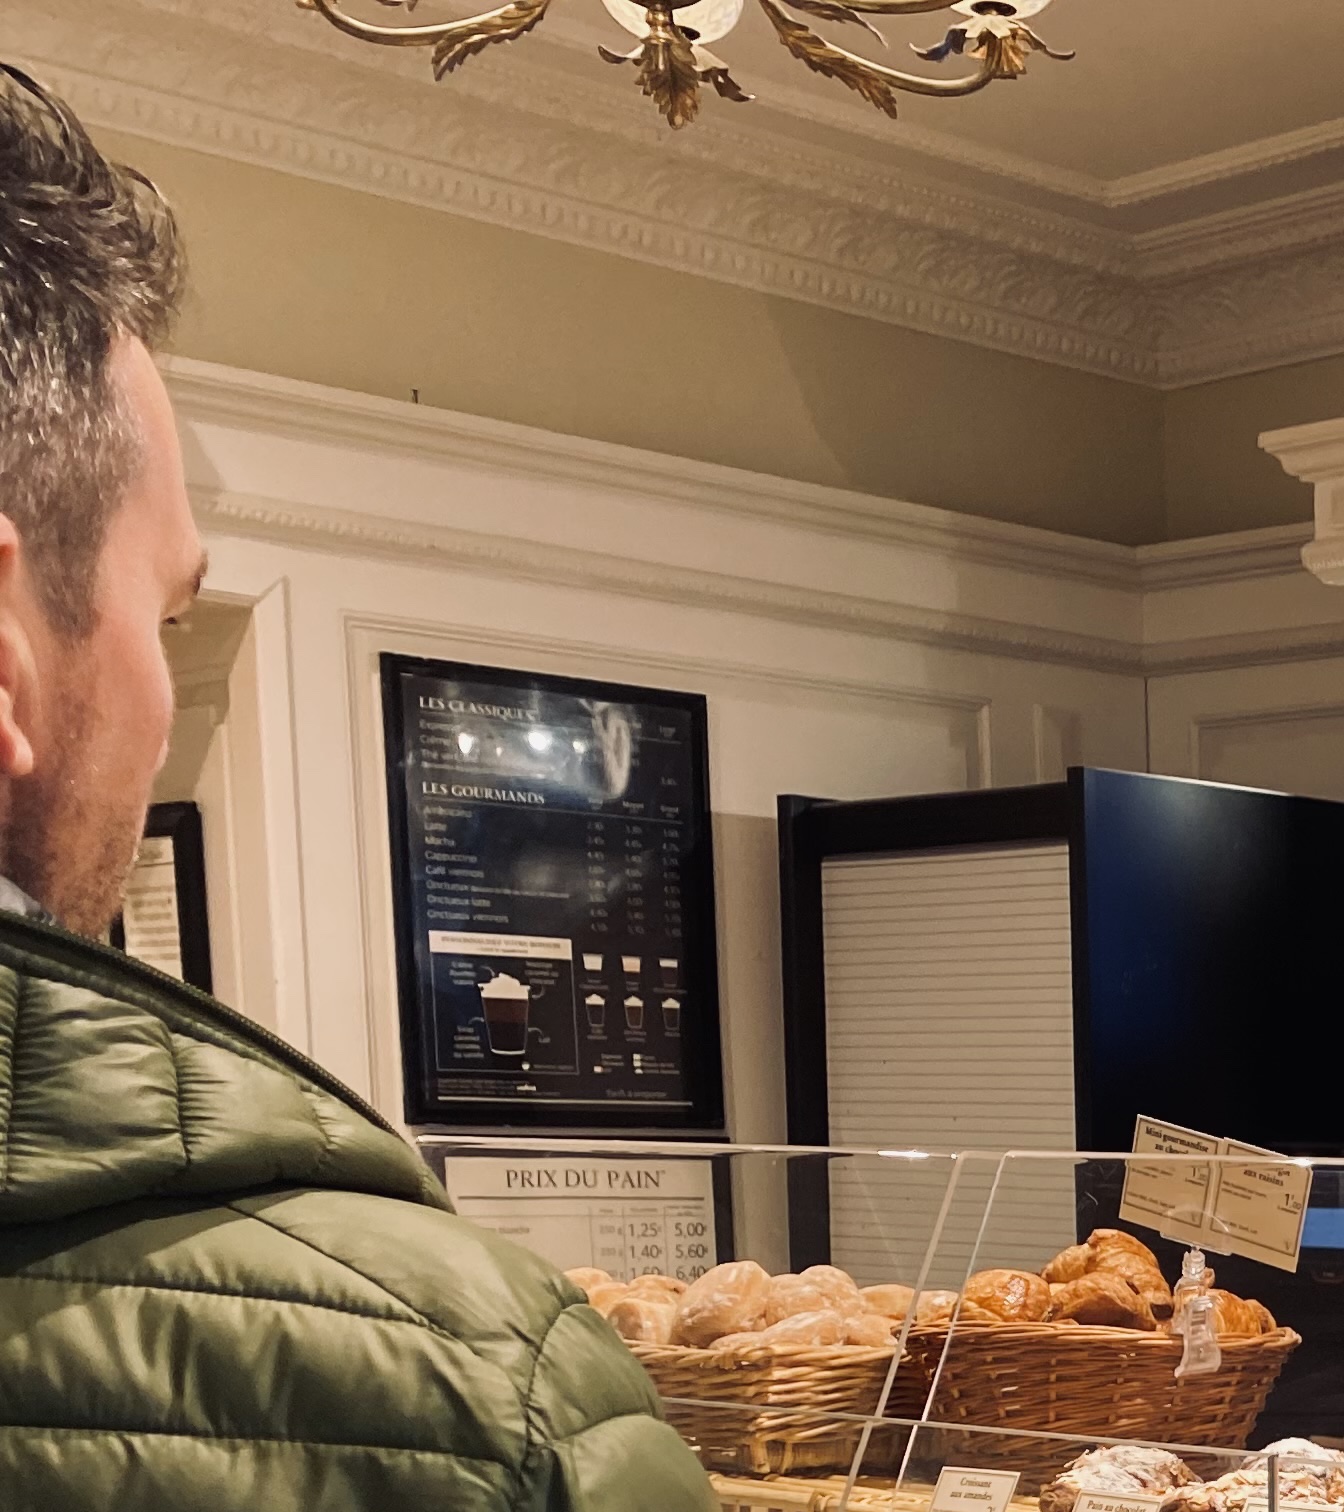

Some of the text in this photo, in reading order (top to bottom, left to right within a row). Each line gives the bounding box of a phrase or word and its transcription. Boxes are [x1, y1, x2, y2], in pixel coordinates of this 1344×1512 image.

[419, 696, 445, 709] LES
[422, 782, 545, 804] LES GOURMANDS
[505, 1169, 662, 1189] PRIX DU PAIN
